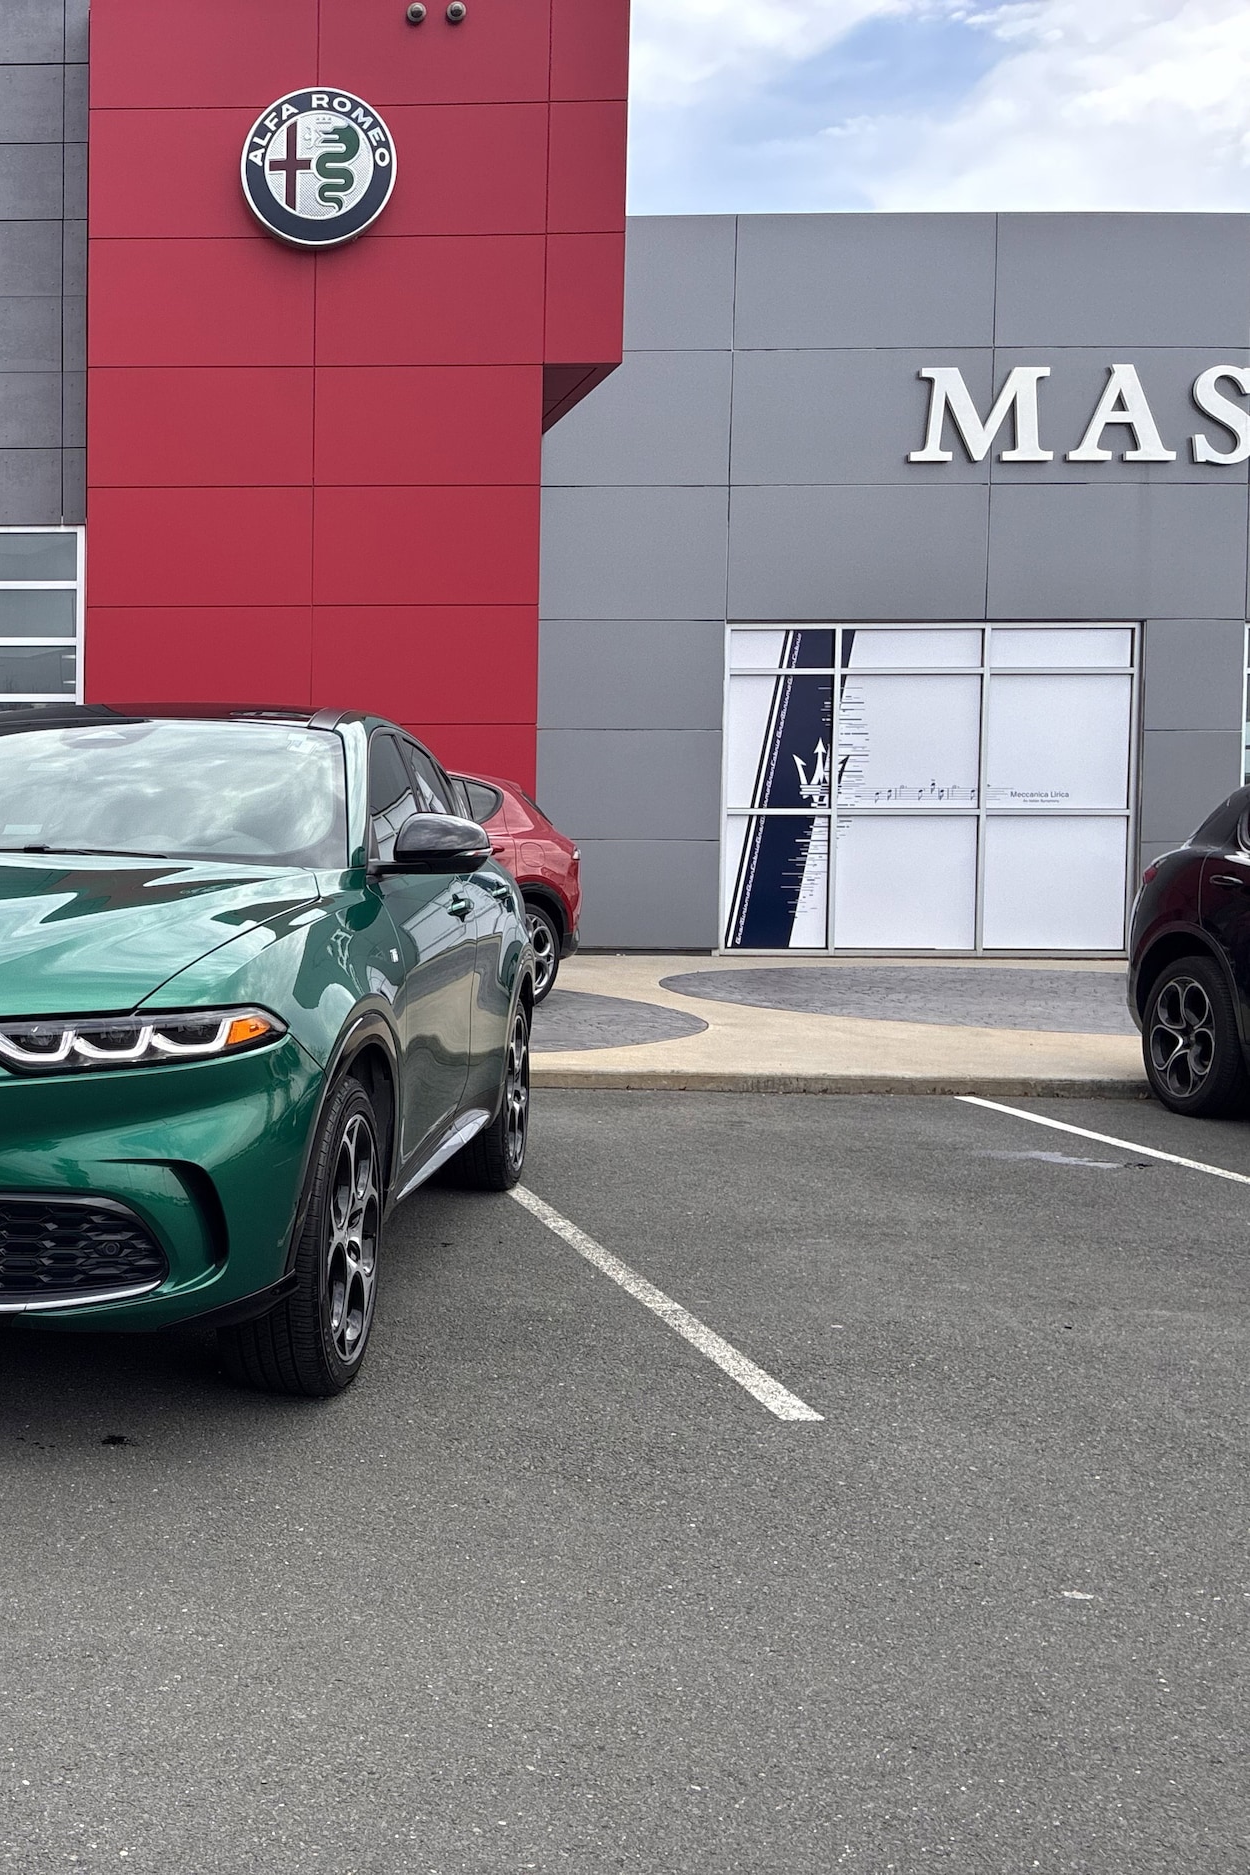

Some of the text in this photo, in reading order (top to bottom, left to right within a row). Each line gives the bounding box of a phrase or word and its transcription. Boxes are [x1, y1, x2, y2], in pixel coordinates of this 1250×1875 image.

[248, 93, 391, 167] ALFA ROMEO
[907, 363, 1250, 465] MAS
